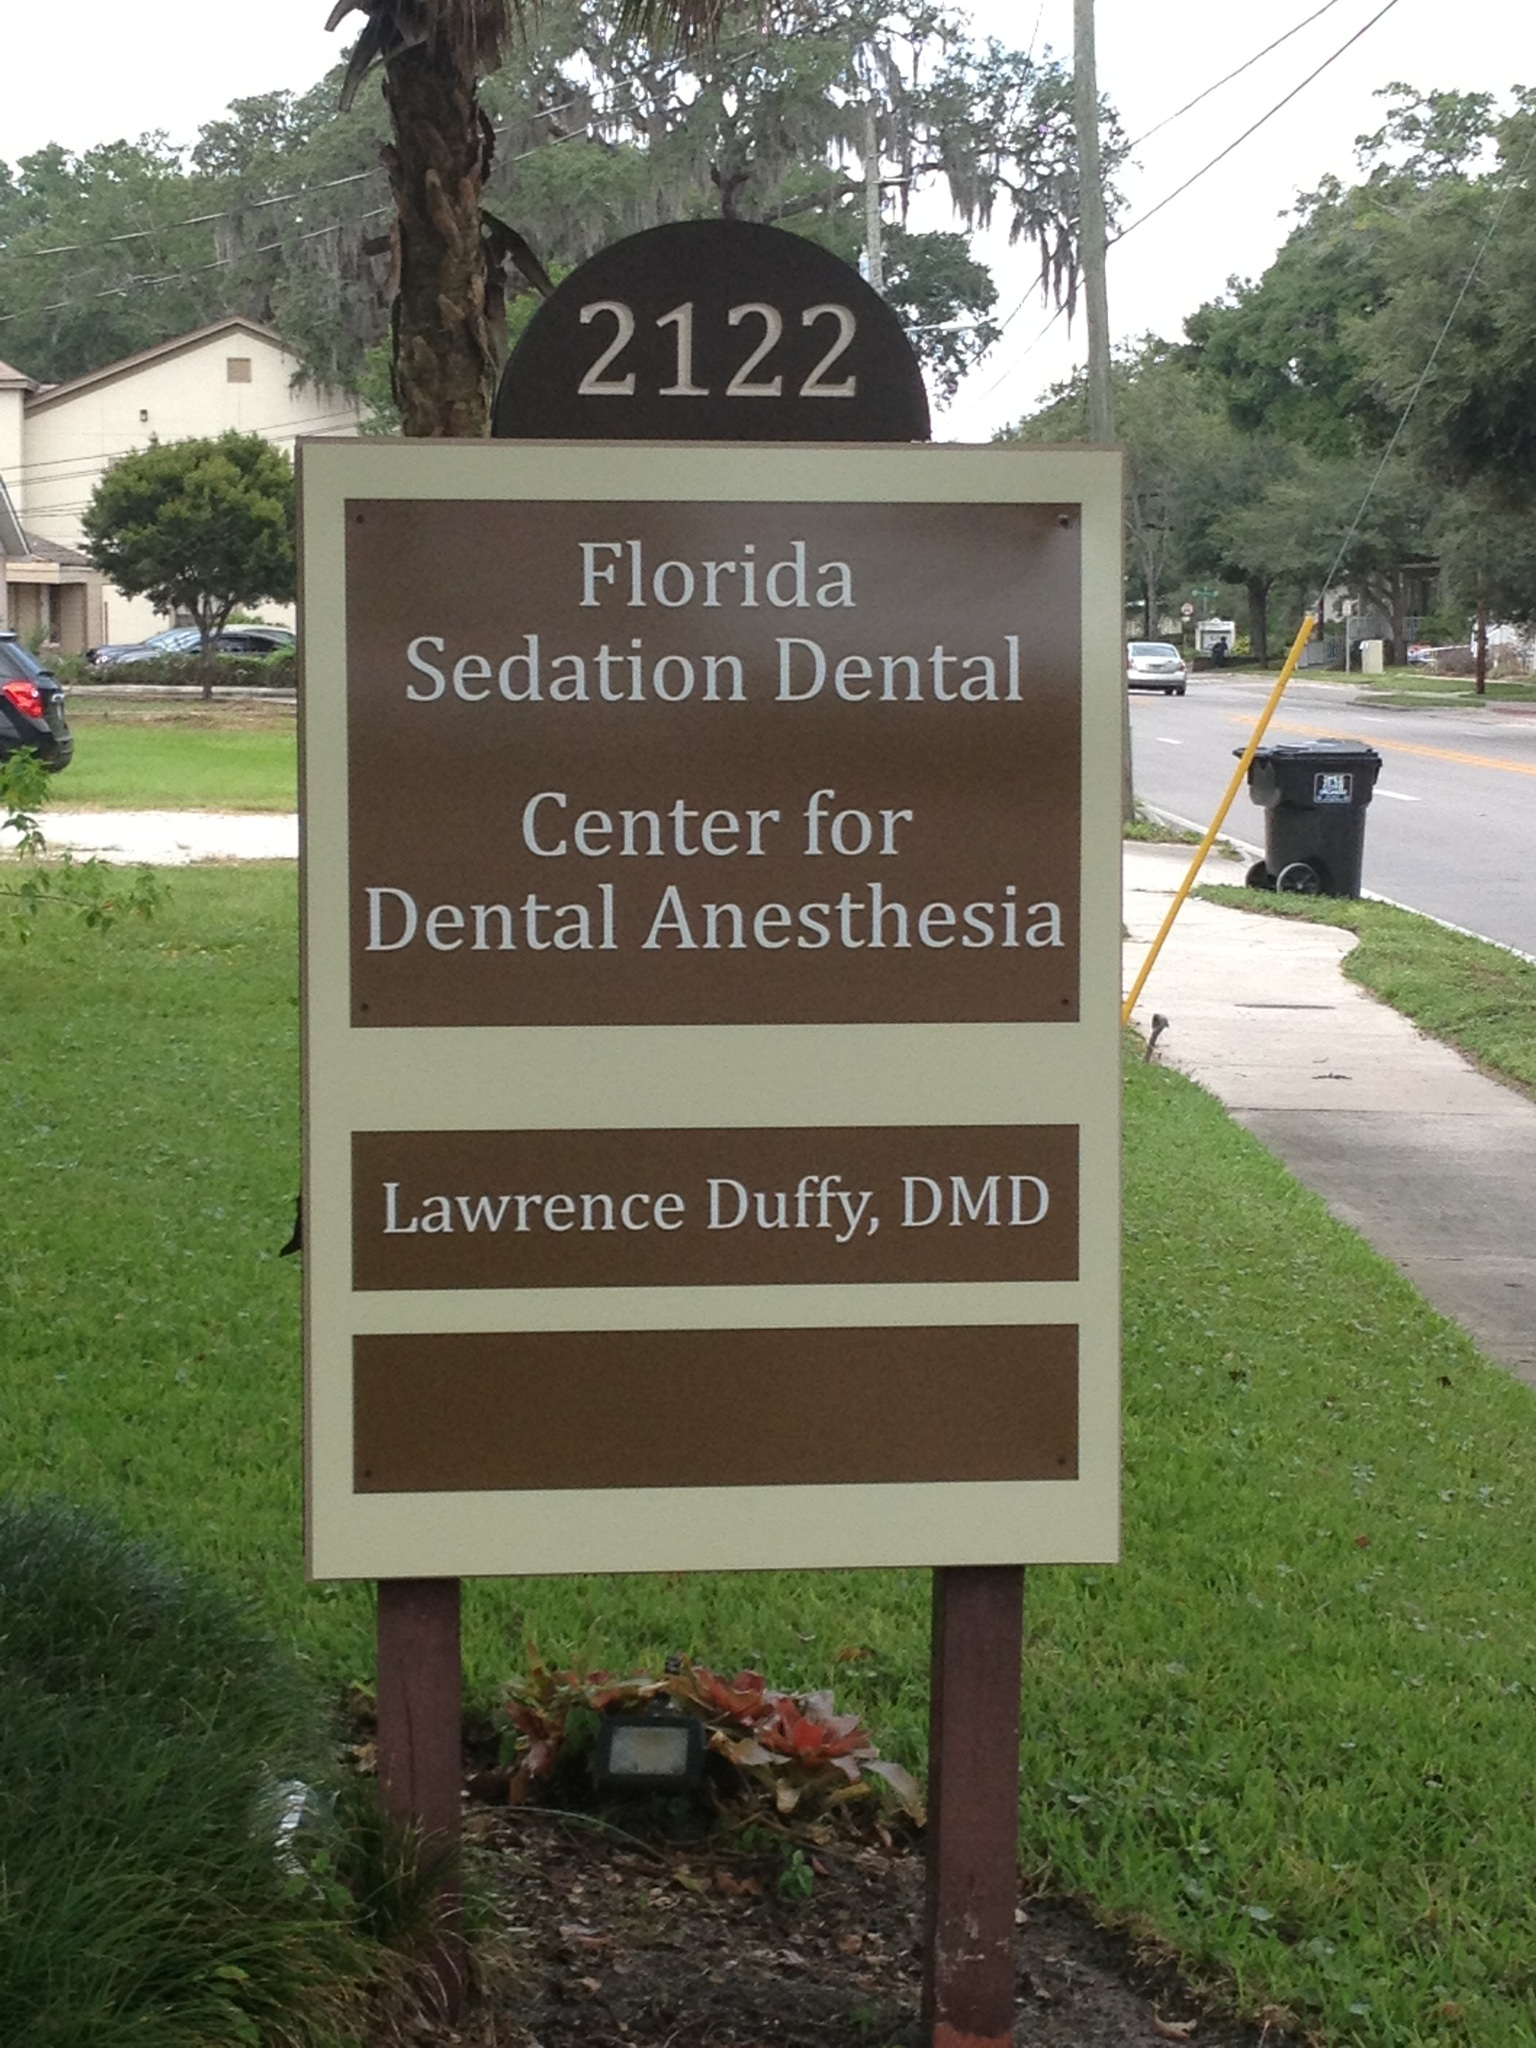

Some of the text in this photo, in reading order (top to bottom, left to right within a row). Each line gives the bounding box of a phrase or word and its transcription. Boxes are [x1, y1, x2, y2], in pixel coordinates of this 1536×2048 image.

[577, 301, 857, 398] 2122
[578, 540, 857, 608] Florida
[406, 633, 1023, 702] Sedation Dental
[522, 789, 914, 857] Center for
[364, 882, 1065, 951] Dental Anesthesia
[382, 1174, 1050, 1243] Lawrence Duffy, DMD
